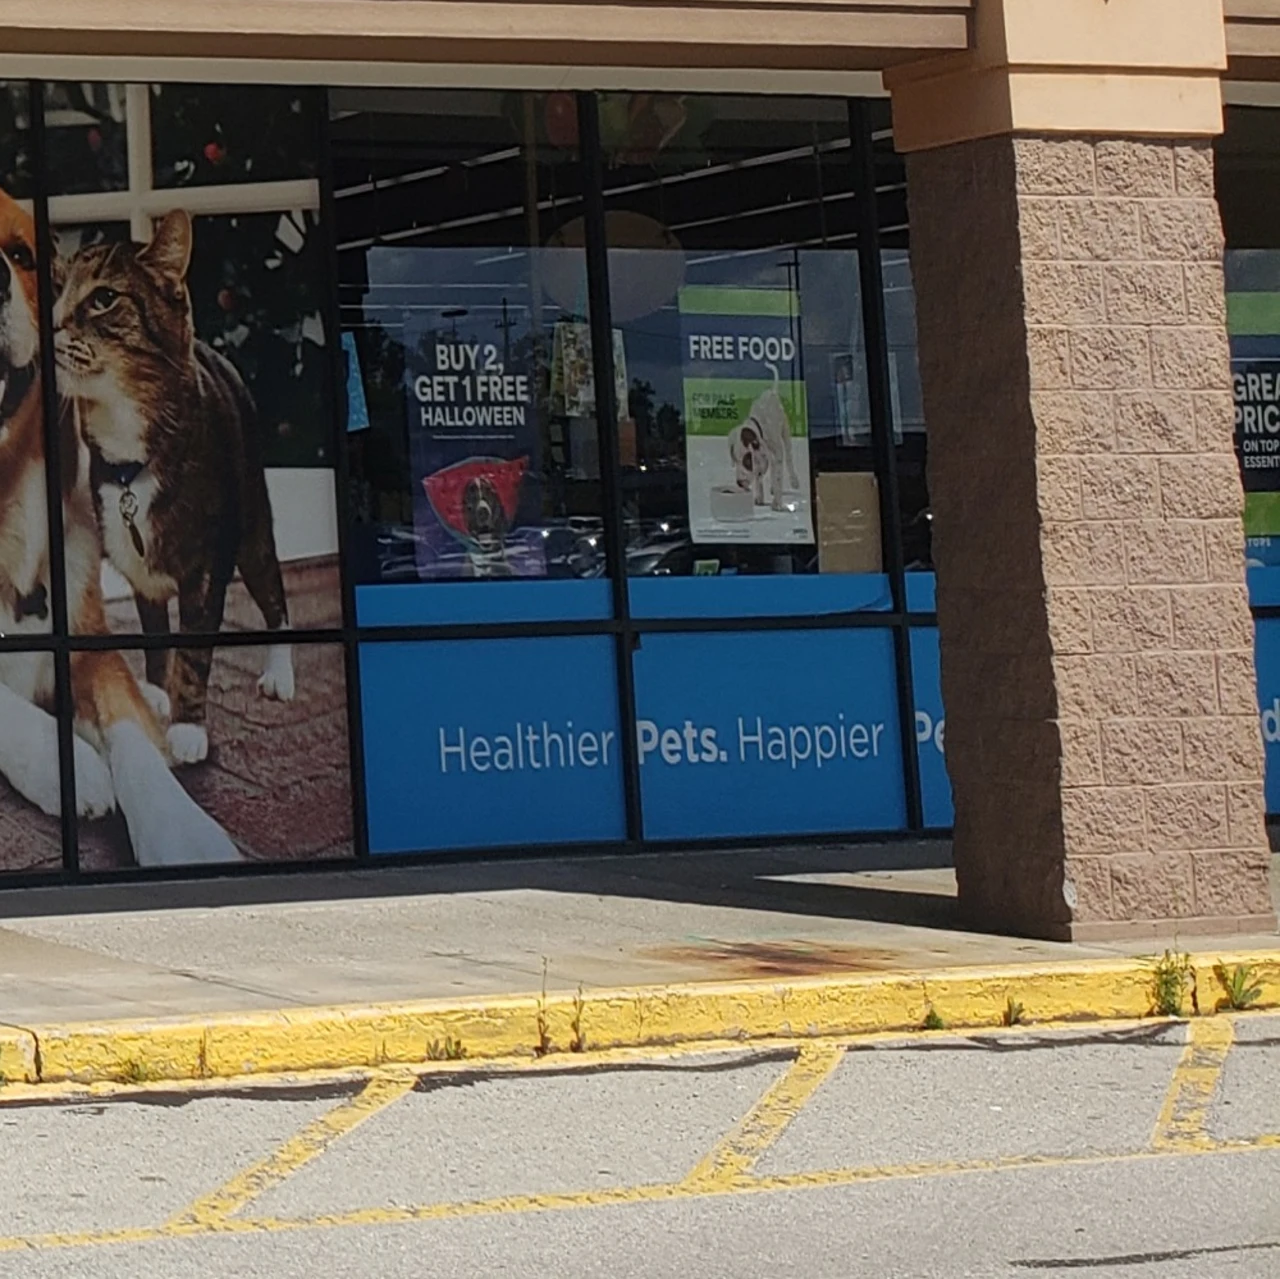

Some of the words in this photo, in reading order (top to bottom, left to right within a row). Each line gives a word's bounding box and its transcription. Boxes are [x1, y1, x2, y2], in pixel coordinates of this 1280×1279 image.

[435, 344, 480, 371] BUY
[484, 344, 504, 375] 2,
[689, 334, 735, 361] FREE
[738, 335, 795, 362] FOOD
[415, 375, 459, 402] GET
[462, 375, 472, 402] 1
[476, 375, 529, 402] FREE
[421, 406, 525, 426] HALLOWEEN
[1243, 440, 1259, 452] ON
[440, 720, 615, 773] Healthier
[636, 720, 728, 765] Pets.
[738, 712, 884, 769] Happier
